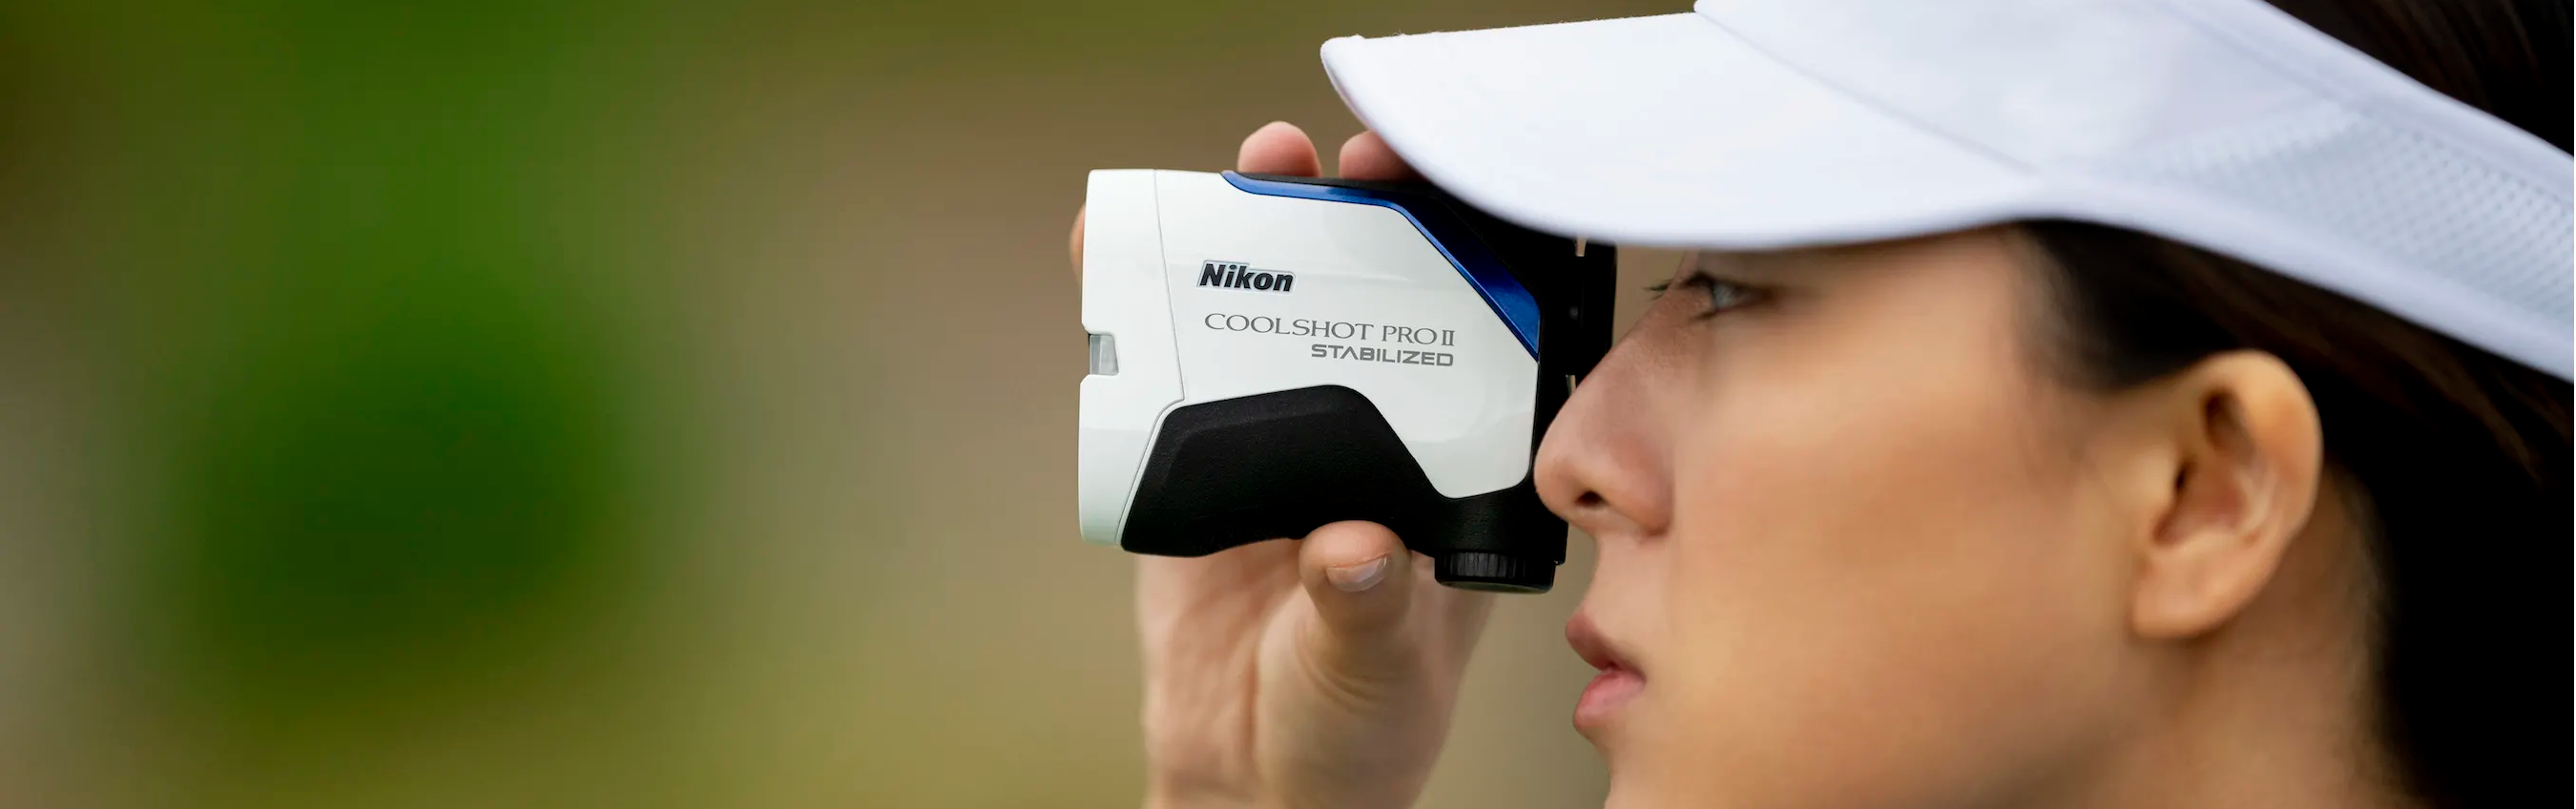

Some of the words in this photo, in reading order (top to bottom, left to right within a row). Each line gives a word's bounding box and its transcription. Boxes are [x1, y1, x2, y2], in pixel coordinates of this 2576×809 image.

[1199, 262, 1295, 292] Nikon
[1204, 313, 1374, 341] COOLSHOT
[1381, 325, 1438, 345] PRO
[1311, 343, 1454, 367] STABILIZED
